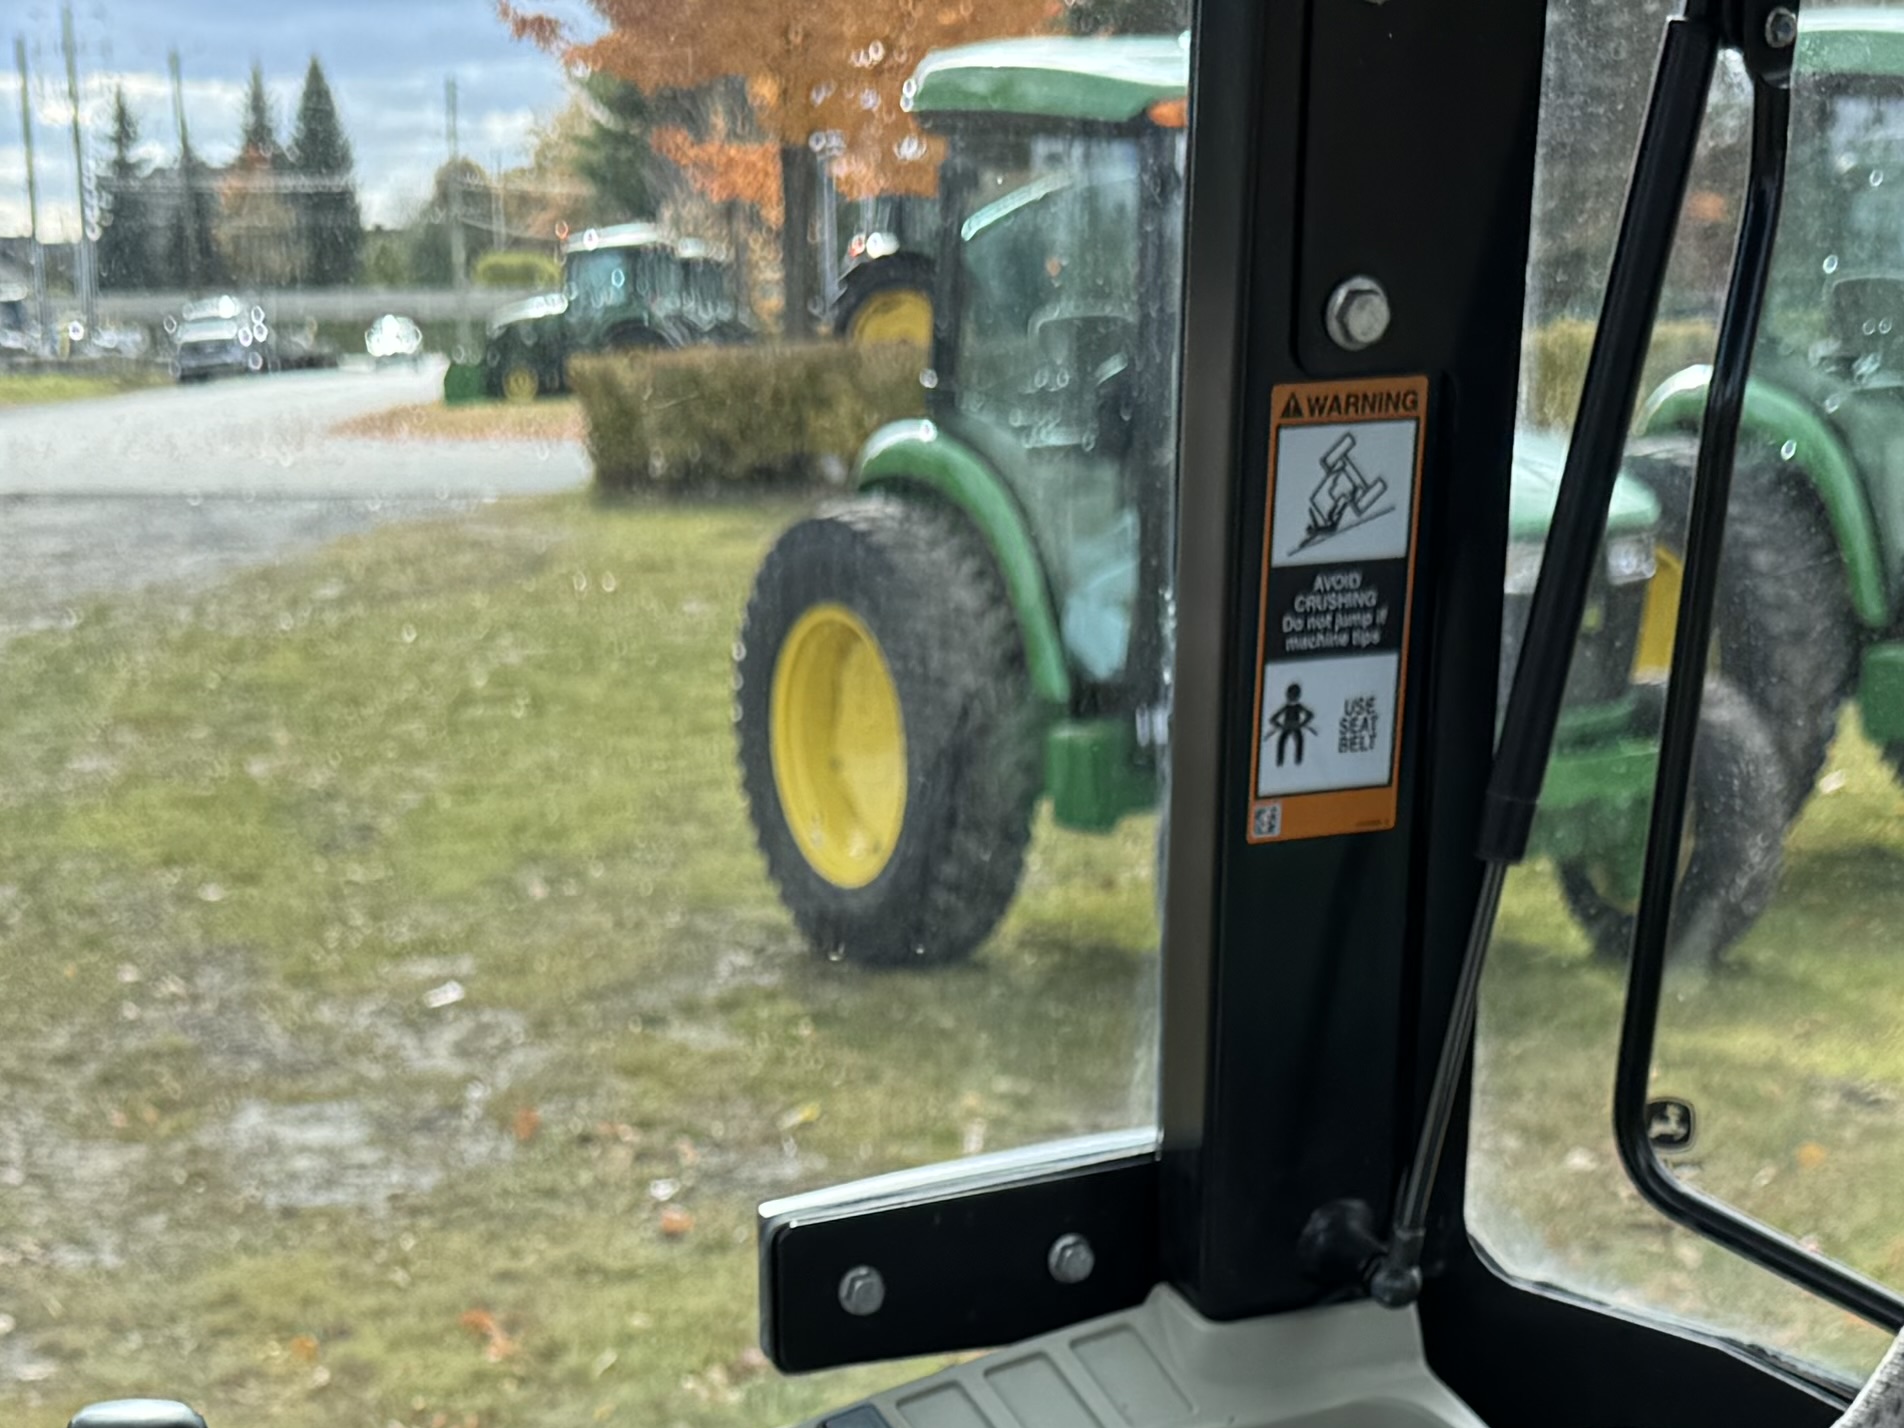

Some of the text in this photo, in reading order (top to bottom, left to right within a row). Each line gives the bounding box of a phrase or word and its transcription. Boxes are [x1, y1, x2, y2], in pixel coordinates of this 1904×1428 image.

[1307, 390, 1418, 417] WARNING
[1313, 573, 1362, 592] AVOID
[1294, 590, 1377, 613] CRUSHING
[1282, 607, 1388, 633] Do not jump if
[1285, 628, 1381, 651] machine tips
[1344, 697, 1377, 716] USE
[1339, 714, 1379, 737] SEAT
[1338, 734, 1378, 754] BELT
